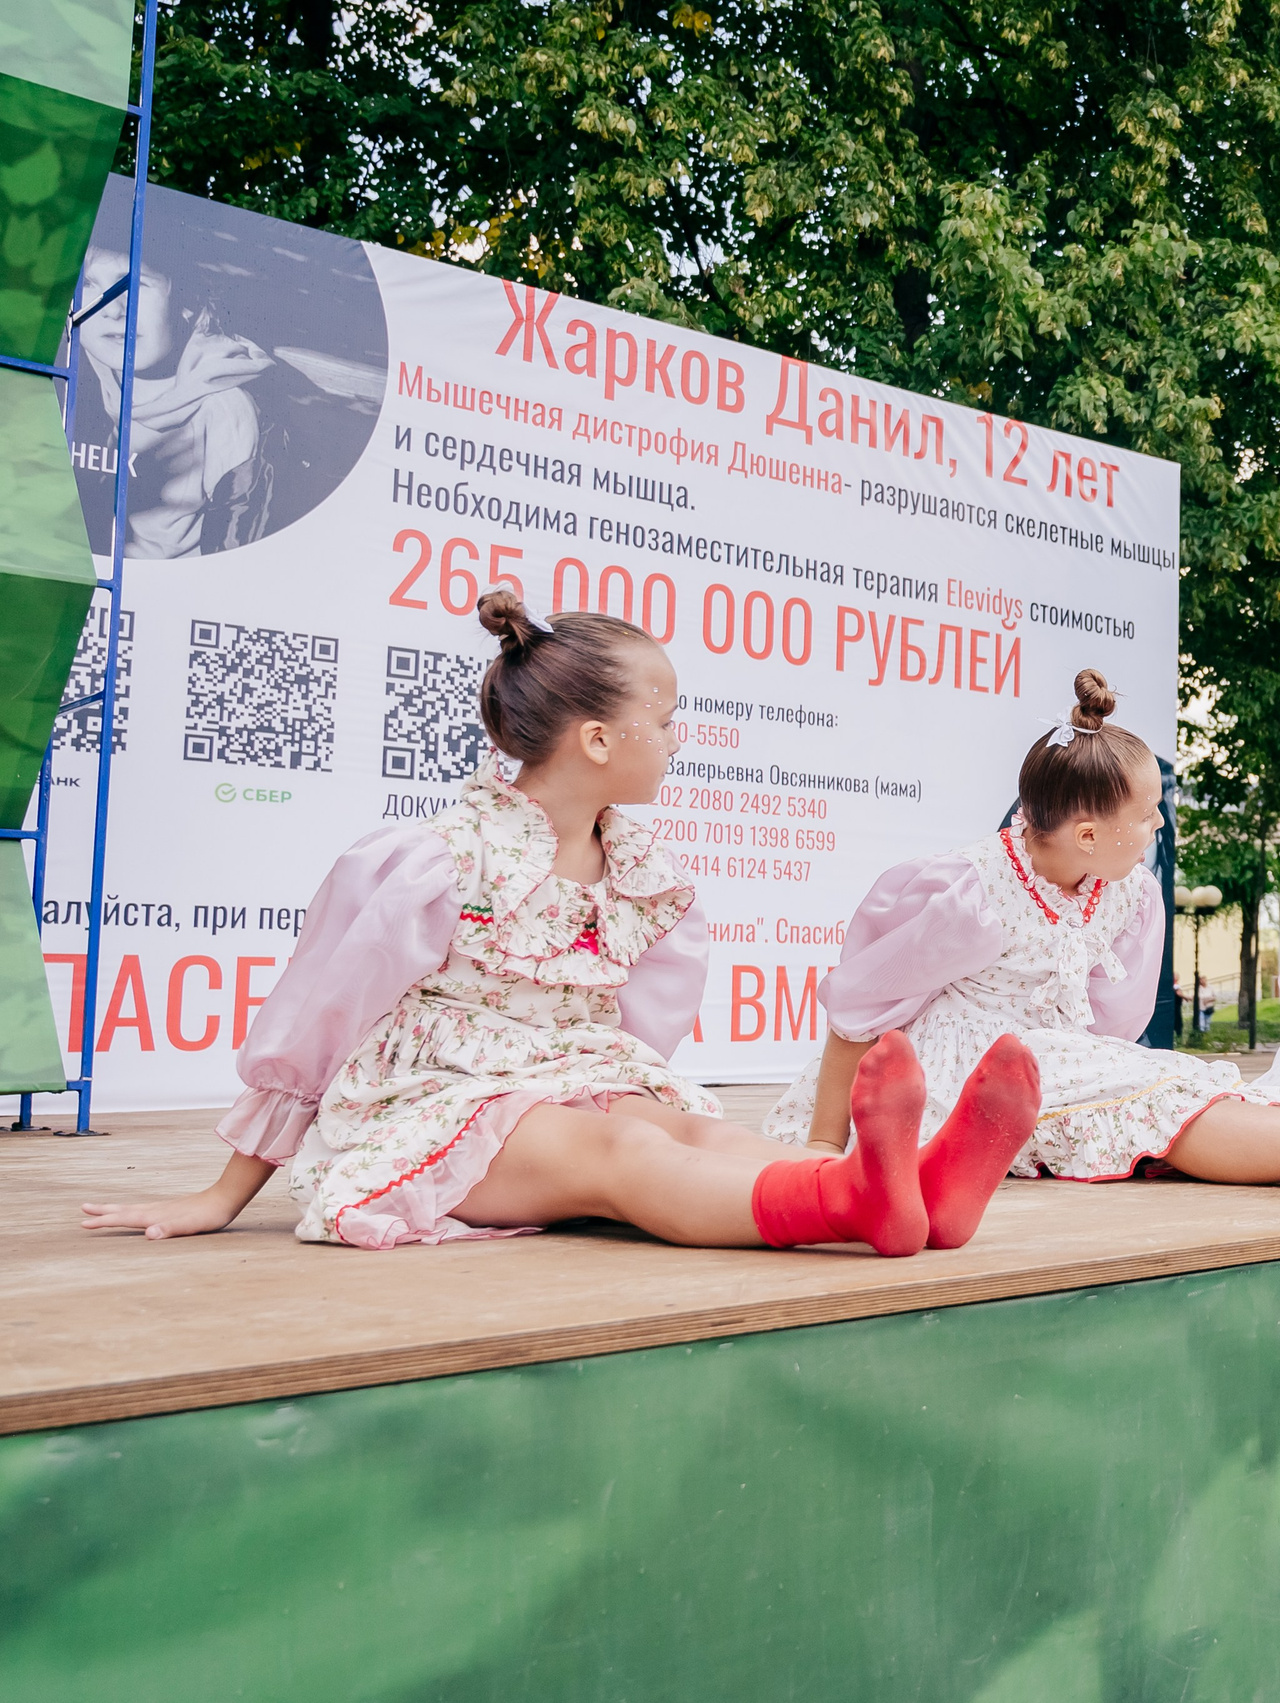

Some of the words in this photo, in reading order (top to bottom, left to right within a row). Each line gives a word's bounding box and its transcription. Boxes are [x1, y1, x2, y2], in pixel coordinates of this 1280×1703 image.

[495, 279, 745, 414] Жарков
[766, 355, 957, 478] Данил,
[977, 413, 1028, 487] 12
[1047, 450, 1120, 508] лет
[394, 424, 412, 452] и
[424, 431, 582, 486] сердечная
[593, 467, 695, 511] мышца.
[398, 361, 563, 431] Мышечная
[572, 413, 719, 466] дистрофия
[728, 441, 851, 494] Дюшенна-
[860, 477, 997, 529] разрушаются
[1005, 512, 1104, 553] скелетные
[1110, 537, 1176, 571] мышцы
[392, 468, 578, 537] Необходима
[589, 516, 844, 586] генозаместительная
[853, 566, 939, 604] терапия
[947, 578, 1023, 622] Elevidys
[1030, 602, 1135, 640] стоимостью
[389, 529, 524, 616] 265
[552, 557, 677, 646] 000
[702, 583, 813, 666] 000
[836, 605, 1021, 699] РУБЛЕЙ
[694, 695, 753, 721] номеру
[759, 704, 839, 728] телефона:
[242, 788, 292, 803] СБЕР
[665, 755, 763, 783] Валерьевна
[770, 764, 869, 794] Овсянникова
[875, 775, 922, 803] (мама)
[382, 793, 463, 821] ДОКУ
[689, 787, 734, 812] 2080
[740, 791, 781, 816] 2492
[787, 796, 827, 820] 5340
[652, 818, 697, 842] 2200
[704, 822, 743, 845] 7019
[750, 826, 789, 848] 1398
[796, 829, 836, 851] 6599
[680, 853, 721, 878] 2414
[727, 856, 767, 880] 6124
[773, 859, 811, 882] 5437
[193, 904, 247, 936] при
[776, 918, 845, 945] Спасиб
[43, 953, 293, 1053] ПАСЕ
[730, 964, 836, 1042] ВМ
